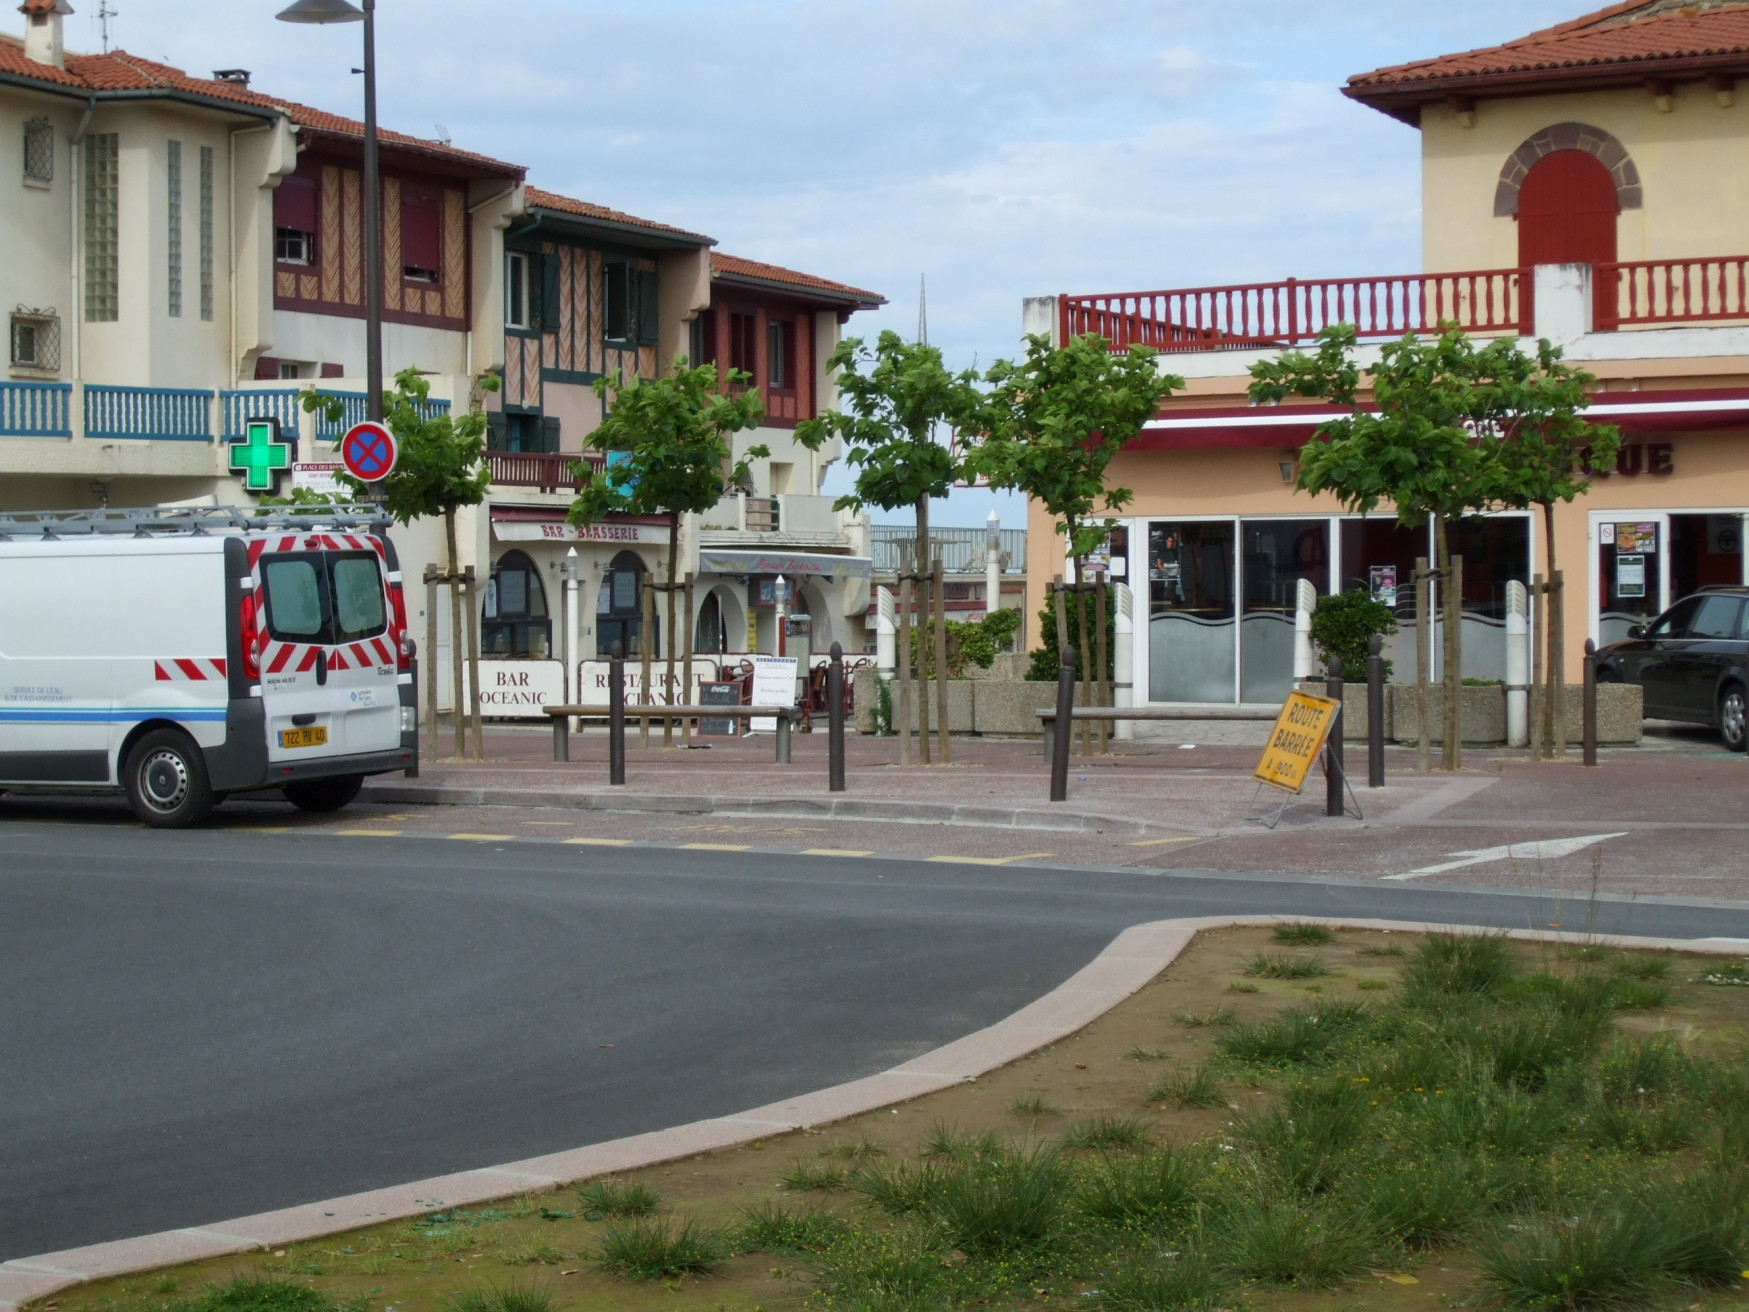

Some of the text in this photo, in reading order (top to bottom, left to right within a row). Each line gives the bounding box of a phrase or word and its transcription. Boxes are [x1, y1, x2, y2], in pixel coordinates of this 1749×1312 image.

[541, 525, 565, 539] BAR
[578, 525, 639, 541] BRASSERIE
[496, 671, 530, 687] BAR
[480, 691, 547, 705] OCEANIC
[1287, 702, 1324, 729] ROUTE
[284, 731, 300, 745] 722
[316, 729, 325, 742] 40
